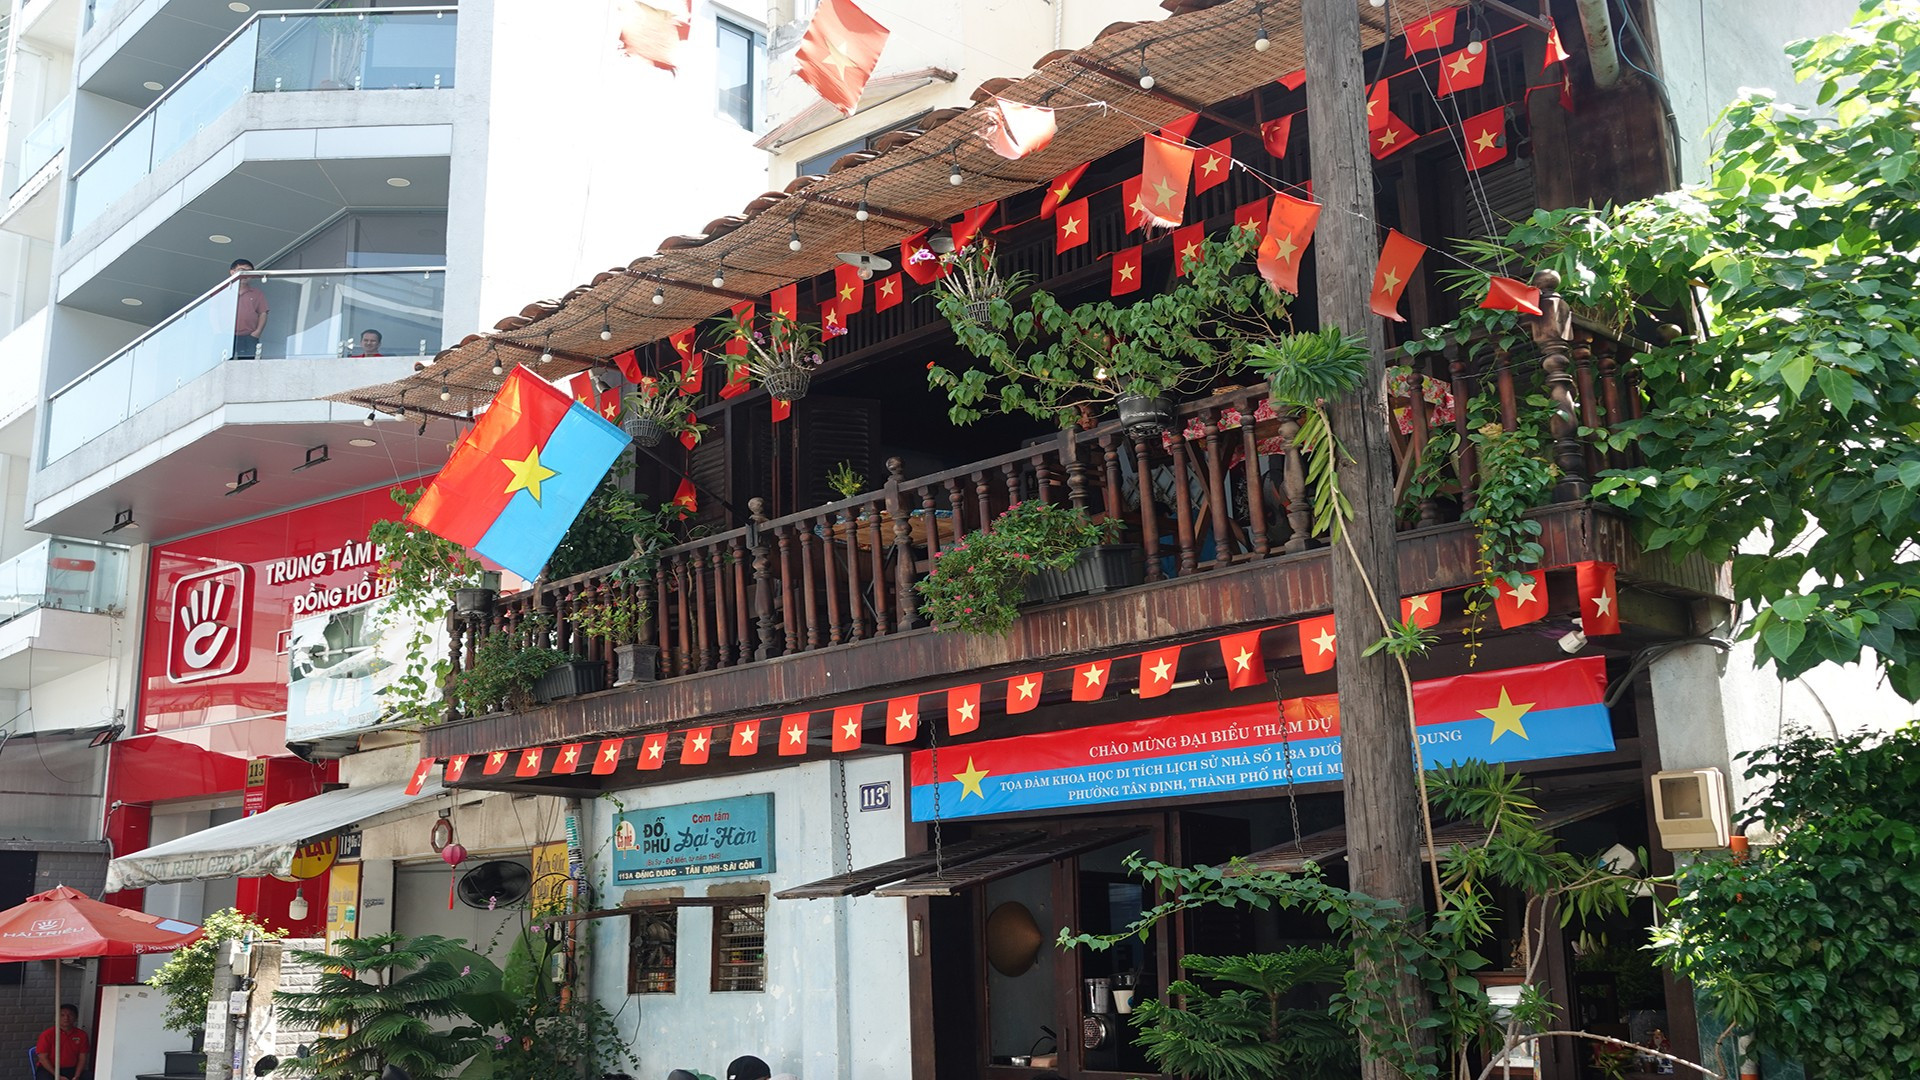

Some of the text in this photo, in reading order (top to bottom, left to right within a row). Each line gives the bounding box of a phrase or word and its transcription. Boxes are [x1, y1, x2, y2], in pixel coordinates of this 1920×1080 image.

[266, 552, 326, 585] TRUNG
[332, 539, 372, 570] TÂM
[293, 582, 342, 613] ĐỒNG
[346, 571, 371, 603] HỒ
[1089, 741, 1129, 758] CHÀO
[1132, 736, 1177, 752] MỪNG
[1180, 732, 1207, 748] ĐẠI
[1211, 722, 1250, 743] BIỂU
[1307, 715, 1333, 733] DỰ
[249, 763, 264, 777] 113
[1000, 781, 1022, 792] TỌA
[1024, 776, 1049, 789] ĐÀM
[1053, 774, 1085, 786] KHOA
[1088, 770, 1114, 783] HỌC
[1116, 769, 1130, 780] DI
[1132, 764, 1163, 777] TÍCH
[1167, 760, 1198, 775] LỊCH
[1200, 754, 1218, 769] SỬ
[1221, 752, 1250, 767] NHÀ
[1253, 747, 1272, 763] SỐ
[1417, 729, 1463, 746] DUNG
[1068, 785, 1119, 800] PHƯỜNG
[1122, 782, 1147, 796] TÂN
[1150, 779, 1187, 794] ĐỊNH,
[1189, 774, 1236, 788] THÀNH
[1240, 766, 1269, 783] PHỐ
[1297, 761, 1324, 777] CHÍ
[643, 816, 665, 838] ĐỖ
[692, 808, 729, 824] Cơm tấm
[643, 833, 670, 854] PHỦ
[172, 854, 204, 876] RIÊU
[656, 868, 677, 877] DUNG
[685, 864, 700, 875] TÂN
[738, 859, 755, 870] GÒN
